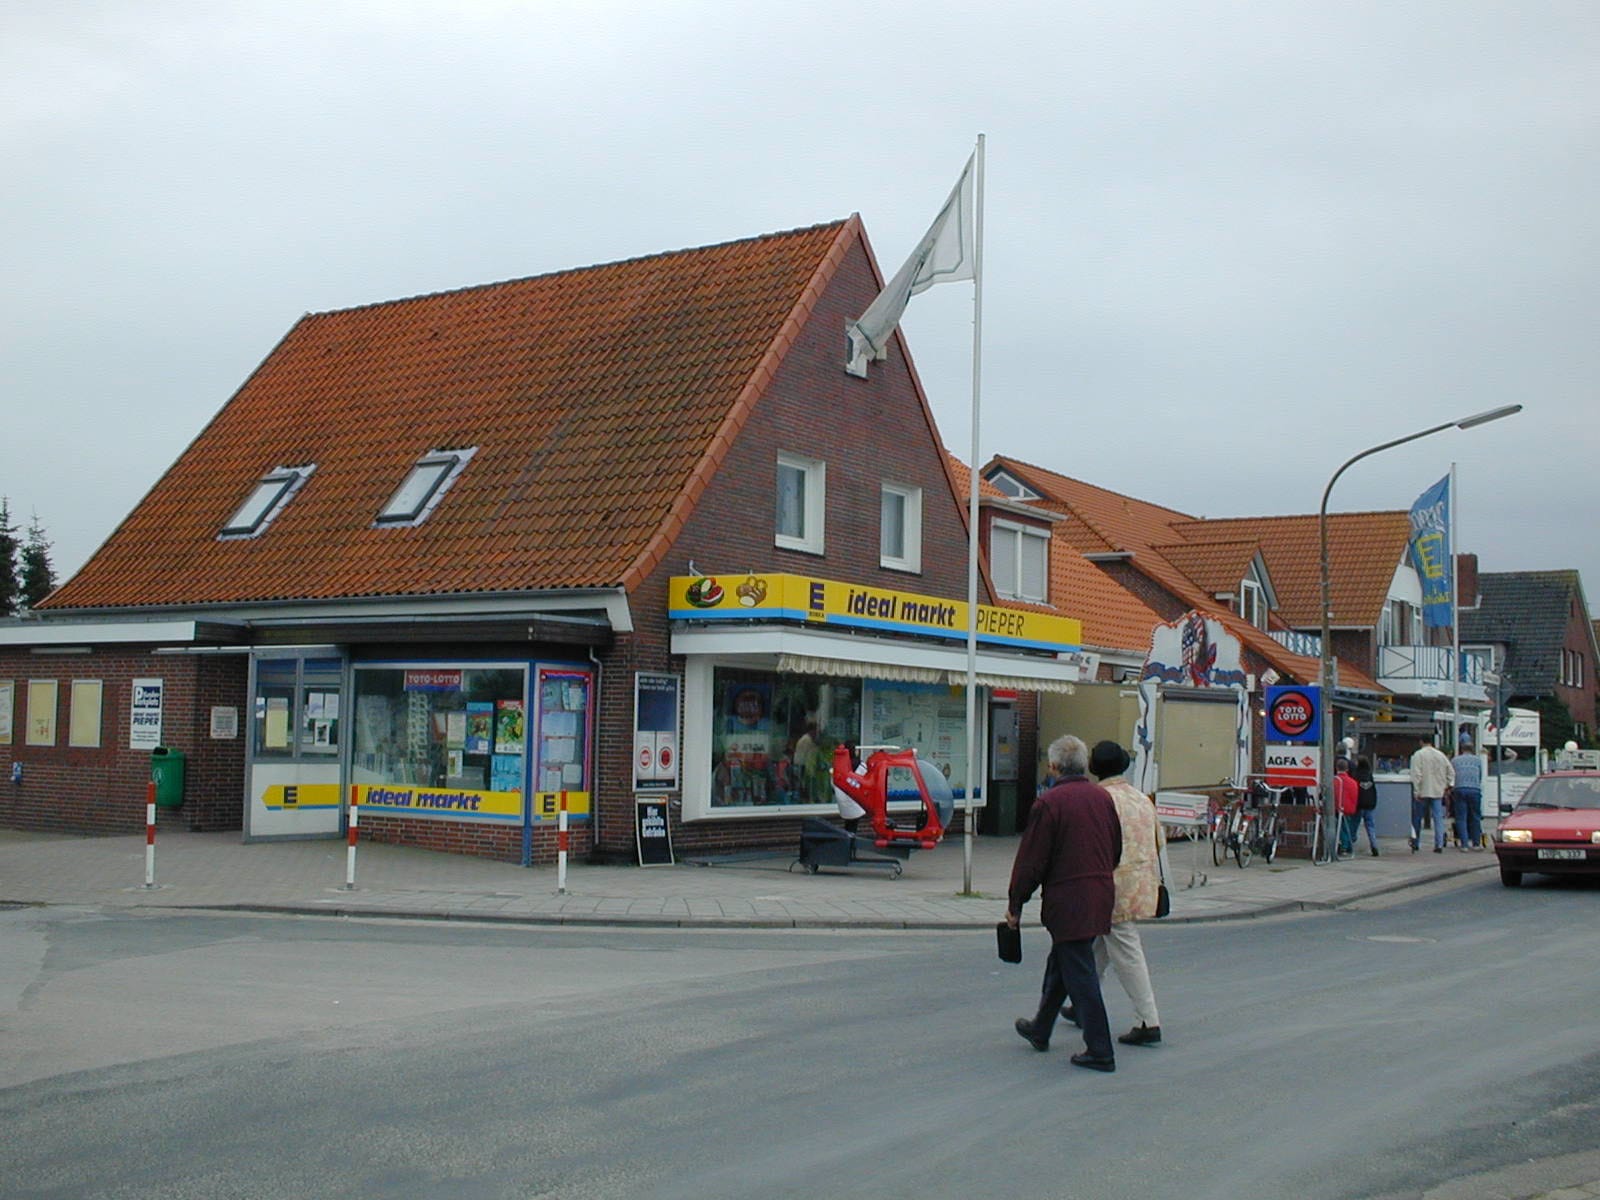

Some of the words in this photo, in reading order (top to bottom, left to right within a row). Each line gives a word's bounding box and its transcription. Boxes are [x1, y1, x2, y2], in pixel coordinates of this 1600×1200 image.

[809, 582, 825, 610] E
[847, 589, 897, 619] ideal
[901, 601, 956, 627] markt
[976, 609, 1025, 637] PIEPER
[408, 674, 460, 684] TOTO-LOTTO
[133, 717, 159, 725] PIEPER
[1278, 713, 1306, 721] LOTTO
[1267, 756, 1297, 766] AGFA
[283, 786, 297, 804] E
[366, 787, 412, 806] ideal
[416, 792, 481, 810] markt
[543, 795, 555, 813] E
